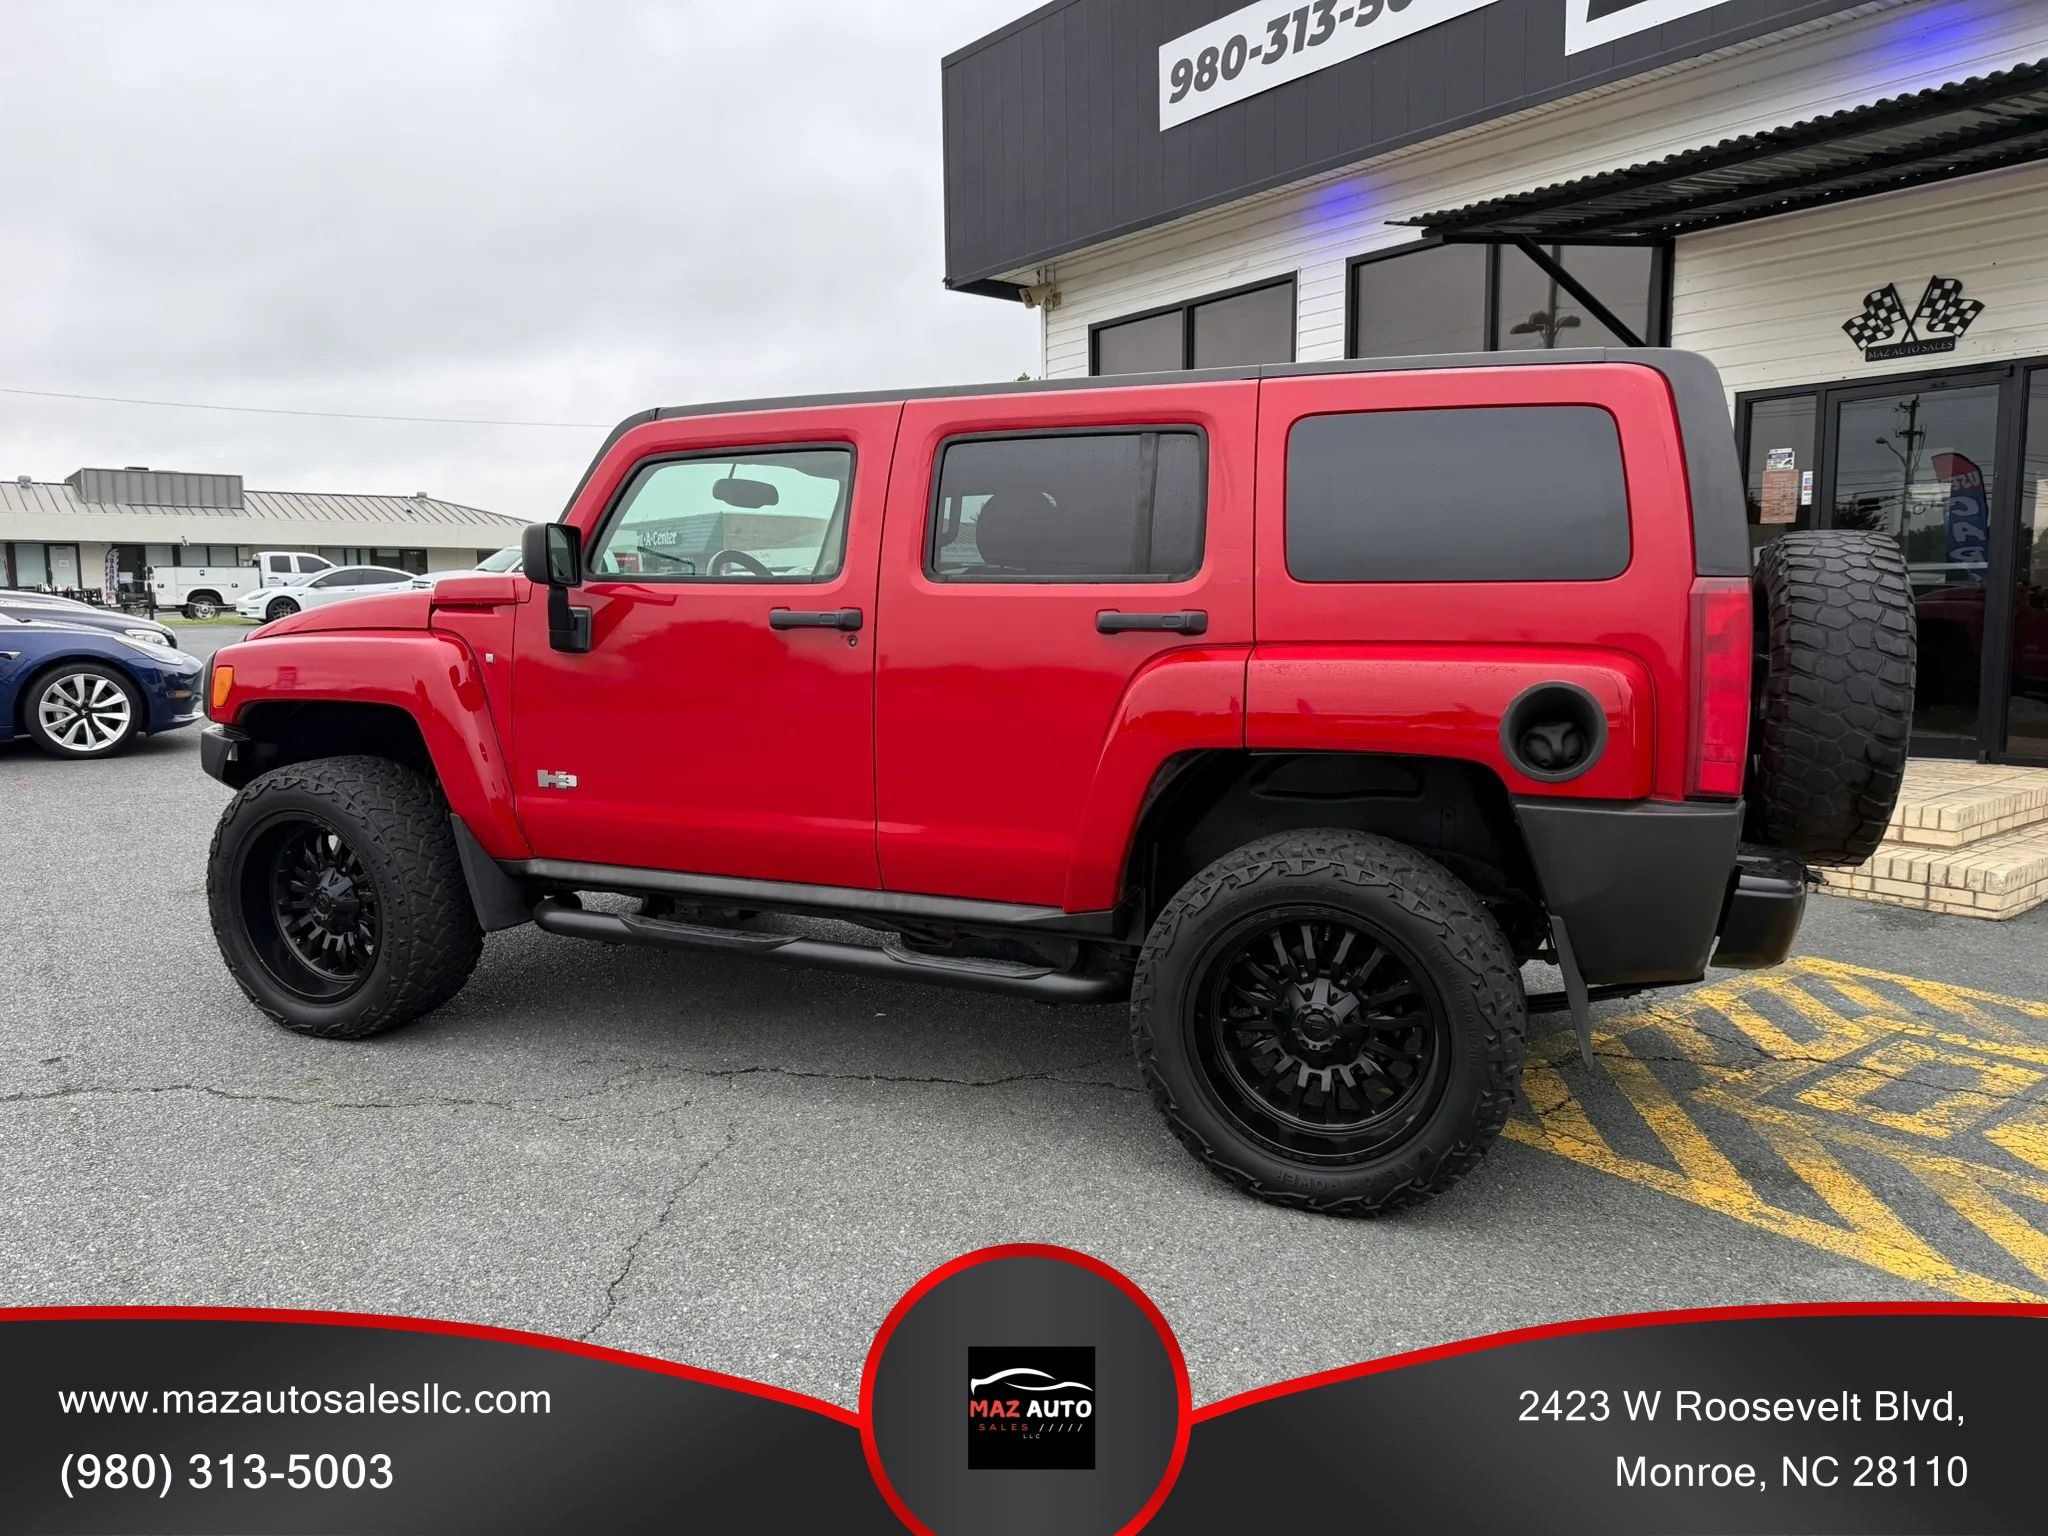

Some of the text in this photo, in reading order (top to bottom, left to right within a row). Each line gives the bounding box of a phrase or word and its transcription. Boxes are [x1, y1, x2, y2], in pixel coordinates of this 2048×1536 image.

[1168, 0, 1414, 104] 980-313-5
[1867, 340, 1954, 360] MAZ AUTO SALES
